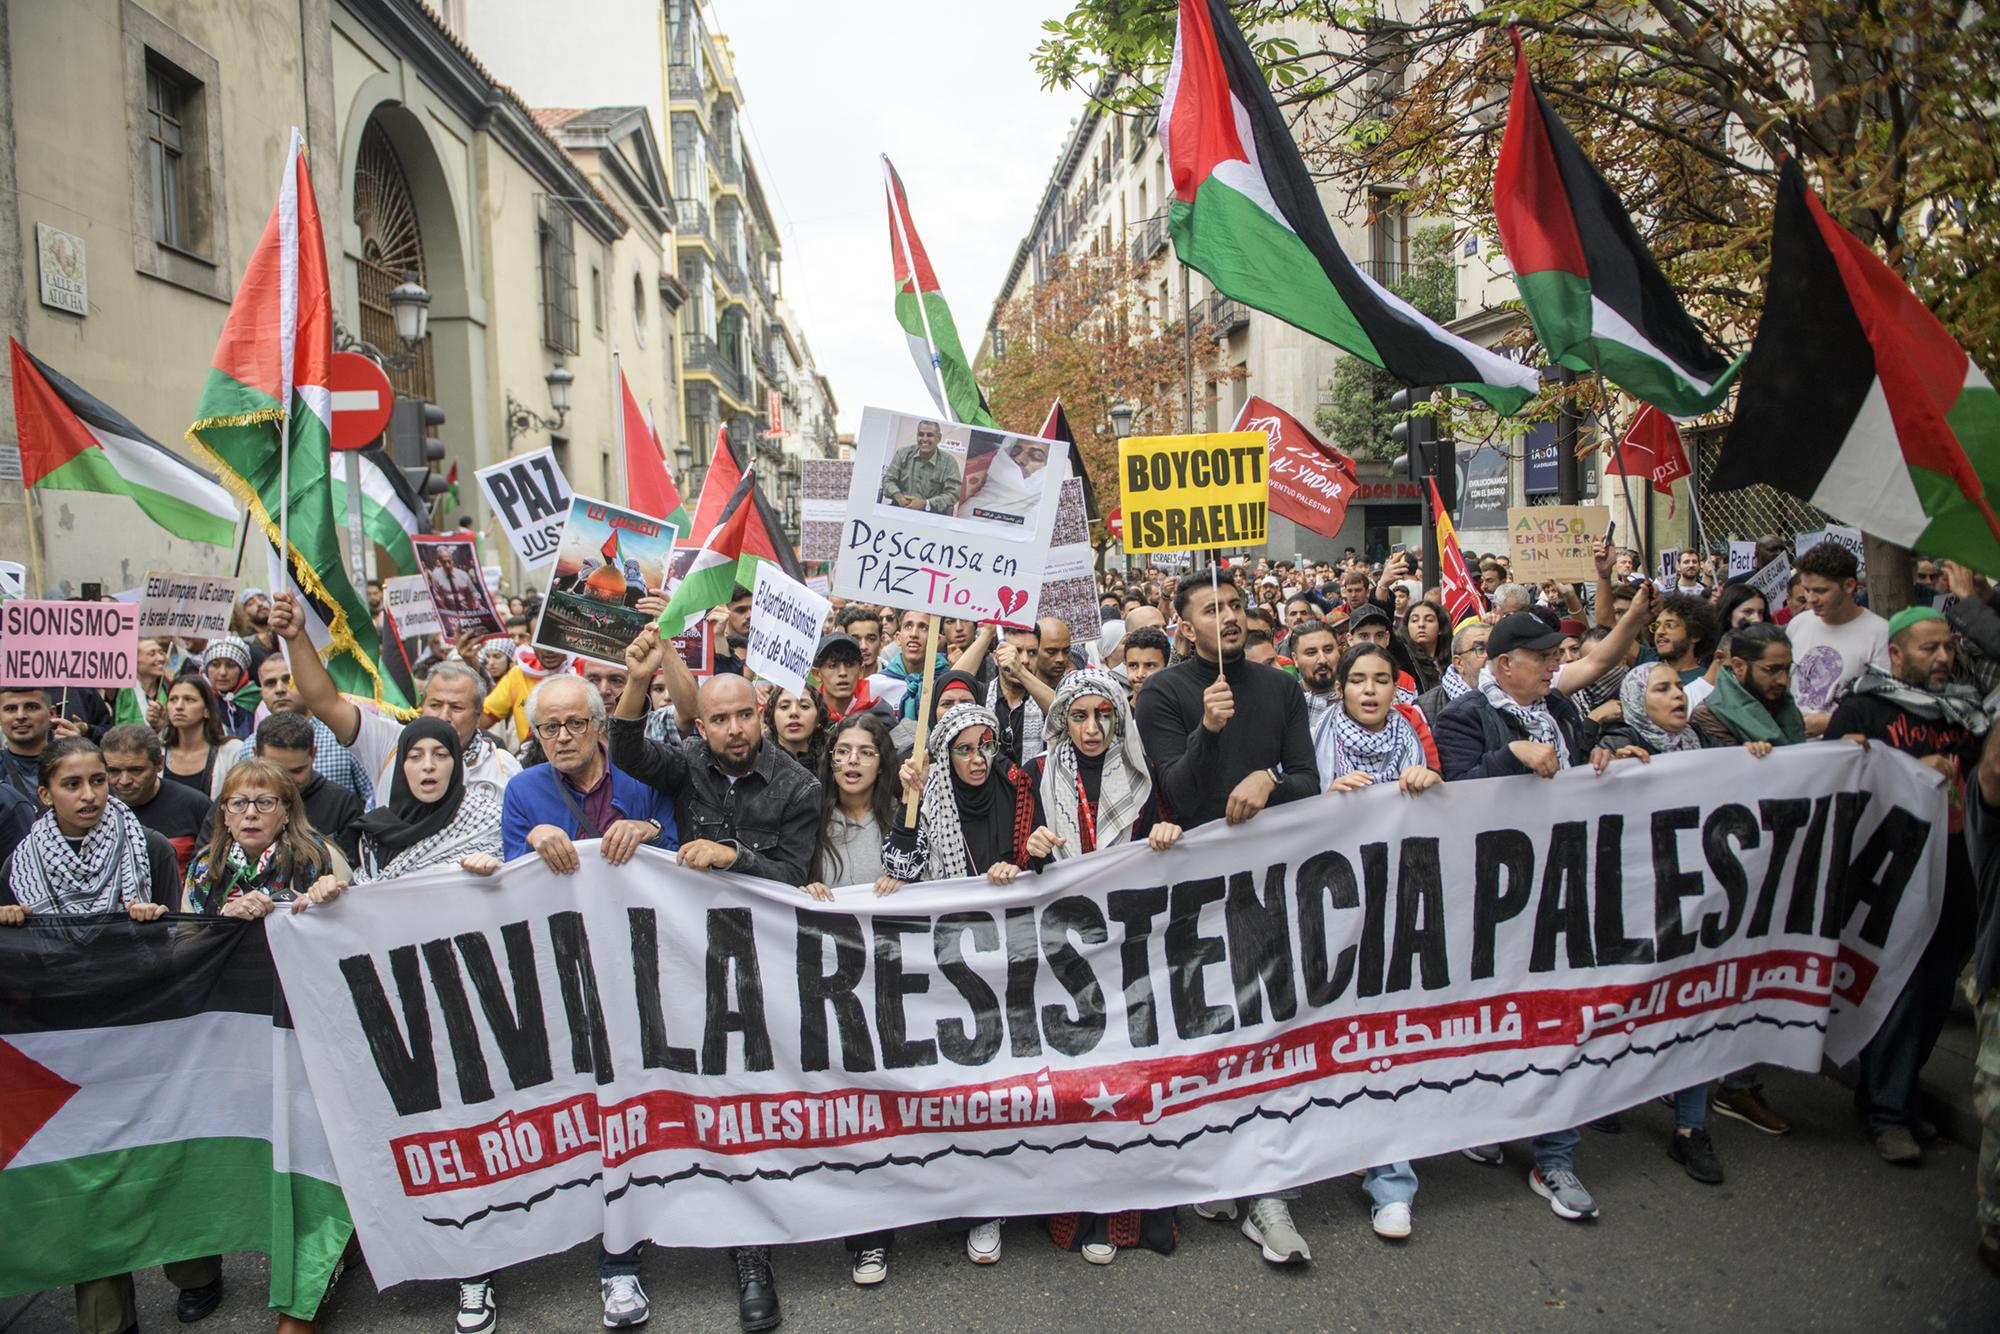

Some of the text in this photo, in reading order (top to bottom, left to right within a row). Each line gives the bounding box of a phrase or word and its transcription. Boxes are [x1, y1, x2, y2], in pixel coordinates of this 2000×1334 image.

[48, 288, 84, 311] ATOCHA
[1127, 446, 1264, 492] BOYCOTT
[1269, 456, 1342, 499] AL-YUDUR
[486, 456, 569, 530] PAZ
[1268, 479, 1331, 515] VENTUD PALESTINA
[587, 503, 660, 538] القدس لنا
[1130, 502, 1265, 549] ISRAEL!!!
[1515, 516, 1585, 534] AYUSO
[848, 519, 1017, 577] Descansa en
[1515, 534, 1600, 545] EMBUSTERA
[1520, 547, 1549, 561] SIN
[147, 577, 170, 597] EEUU
[199, 582, 213, 600] UE
[857, 554, 920, 595] PAZ
[389, 590, 412, 606] EEUU
[8, 606, 134, 636] SIONISMO=
[147, 608, 169, 627] Israel
[168, 612, 195, 628] arrasa
[194, 614, 202, 632] y
[202, 614, 225, 631] mata.
[6, 650, 132, 680] NEONAZISMO.
[767, 634, 781, 662] de
[339, 911, 614, 1116] VIVA
[627, 907, 774, 1075] LA
[795, 836, 1450, 1074] RESISTENCIA
[1576, 980, 1671, 1044] البحر
[1331, 1001, 1522, 1071] فلسطين
[1143, 1043, 1317, 1123] ستنتصر
[403, 1137, 476, 1187] DEL
[484, 1117, 545, 1177] RÍO
[553, 1103, 599, 1155] AL
[600, 1104, 648, 1161] AR
[694, 1093, 885, 1144] PALESTINA
[897, 1072, 1056, 1129] VENCERÁ
